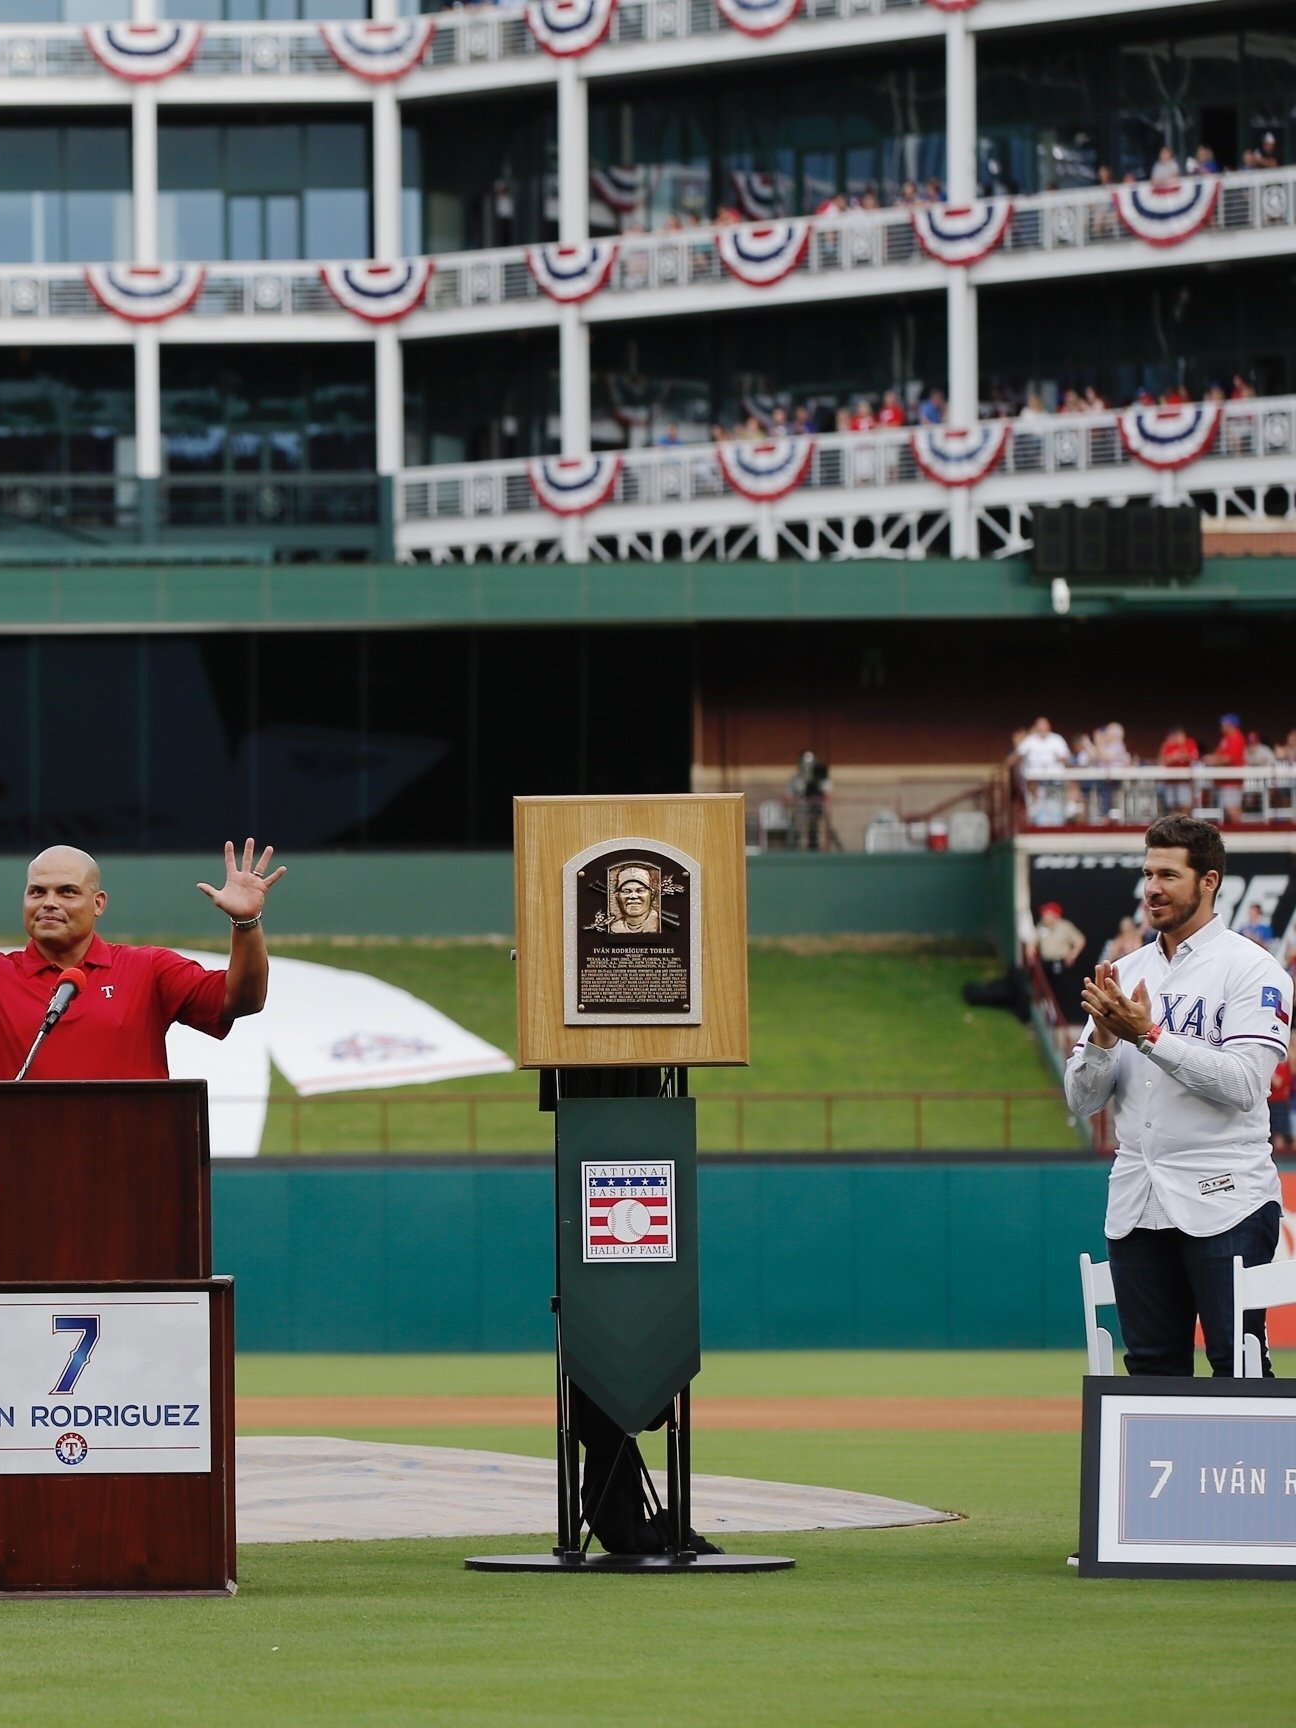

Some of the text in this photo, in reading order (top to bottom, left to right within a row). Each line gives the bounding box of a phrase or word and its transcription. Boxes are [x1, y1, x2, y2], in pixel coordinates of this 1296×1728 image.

[593, 946, 610, 954] IVÁN
[611, 946, 649, 954] RODRÍGUEZ
[100, 985, 114, 999] T
[589, 1167, 668, 1177] NATIONAL
[589, 1187, 668, 1197] BASEBALL
[590, 1245, 669, 1255] HALL OF FAME
[48, 1313, 101, 1395] 7
[31, 1404, 200, 1428] RODRIGUEZ
[65, 1442, 78, 1457] T
[1149, 1460, 1174, 1499] 7
[1200, 1460, 1266, 1495] IVÁN
